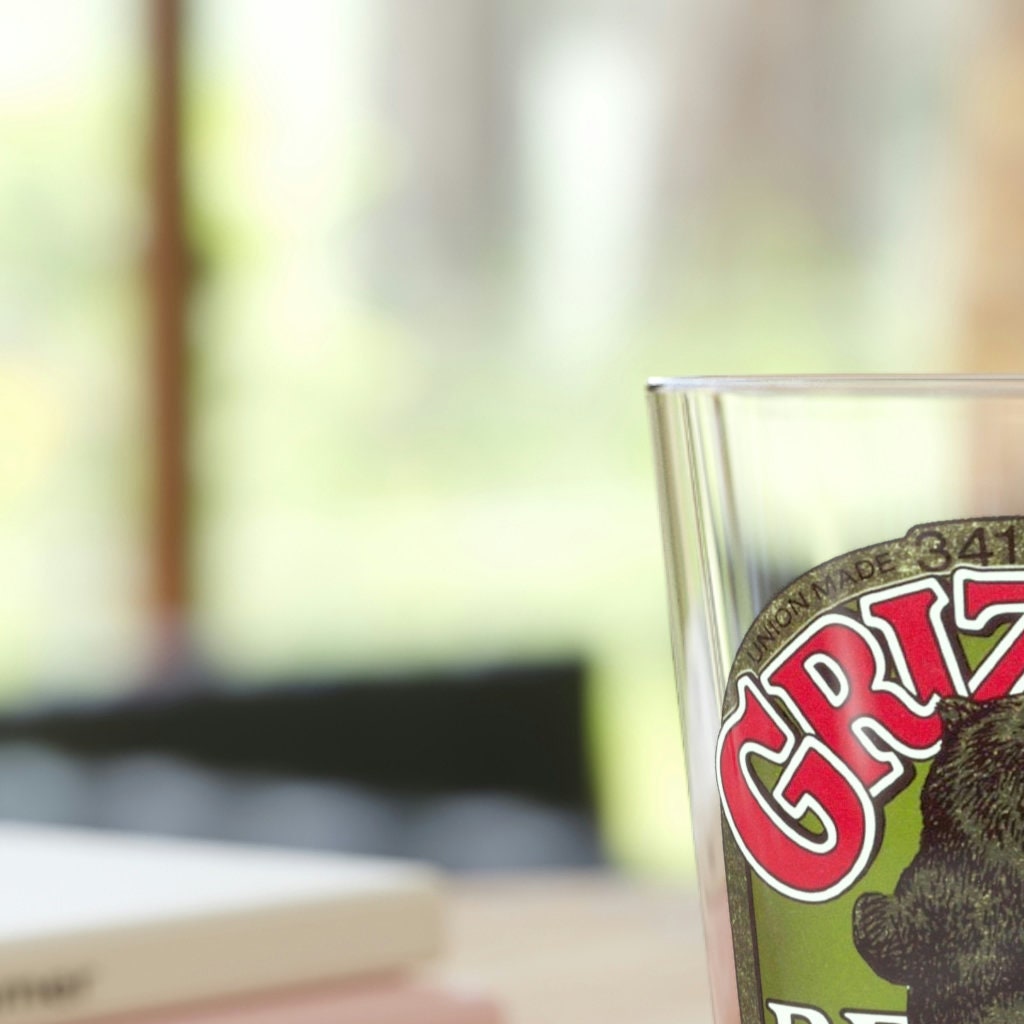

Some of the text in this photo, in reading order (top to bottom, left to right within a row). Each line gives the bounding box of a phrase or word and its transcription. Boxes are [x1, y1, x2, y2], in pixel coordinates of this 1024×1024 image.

[911, 526, 1016, 572] 341
[746, 551, 896, 665] UNION MADE
